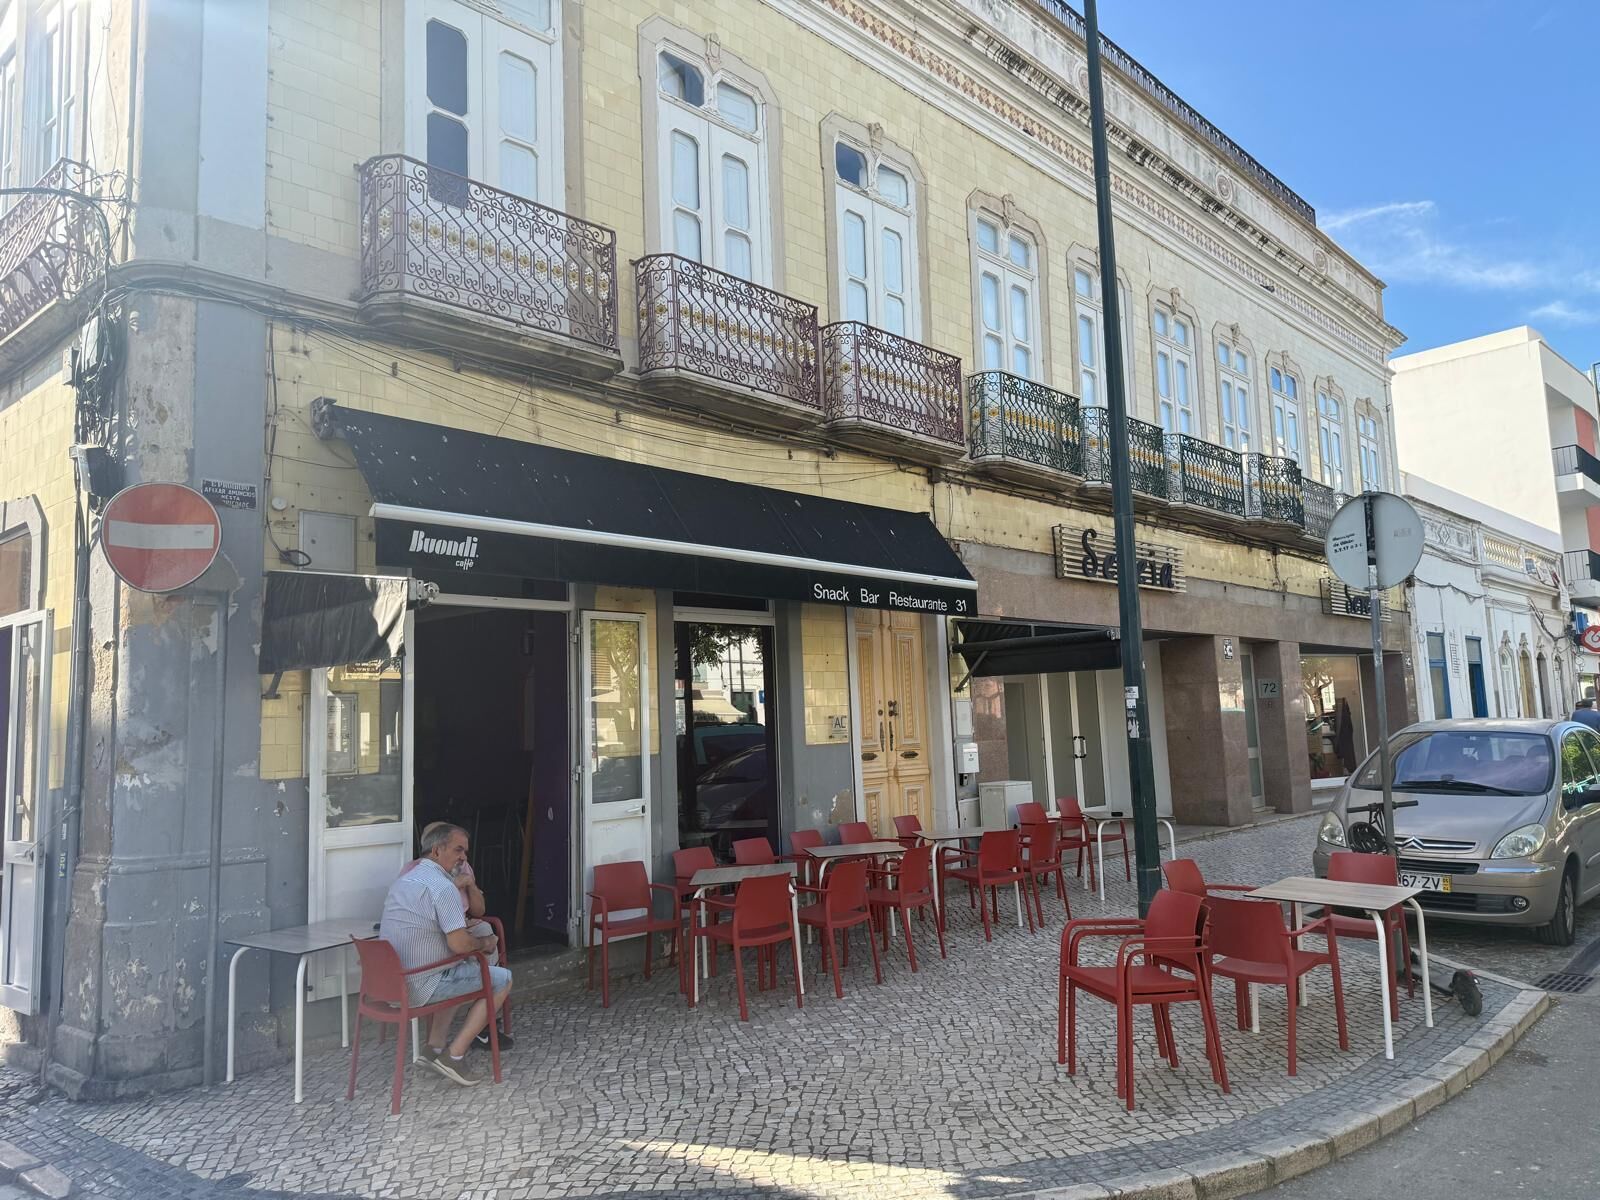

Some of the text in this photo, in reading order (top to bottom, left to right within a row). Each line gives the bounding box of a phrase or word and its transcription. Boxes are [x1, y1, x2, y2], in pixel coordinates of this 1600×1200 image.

[409, 530, 478, 557] Buondi
[813, 583, 967, 612] Snack Bar Restaurante 31
[1263, 682, 1277, 693] 72
